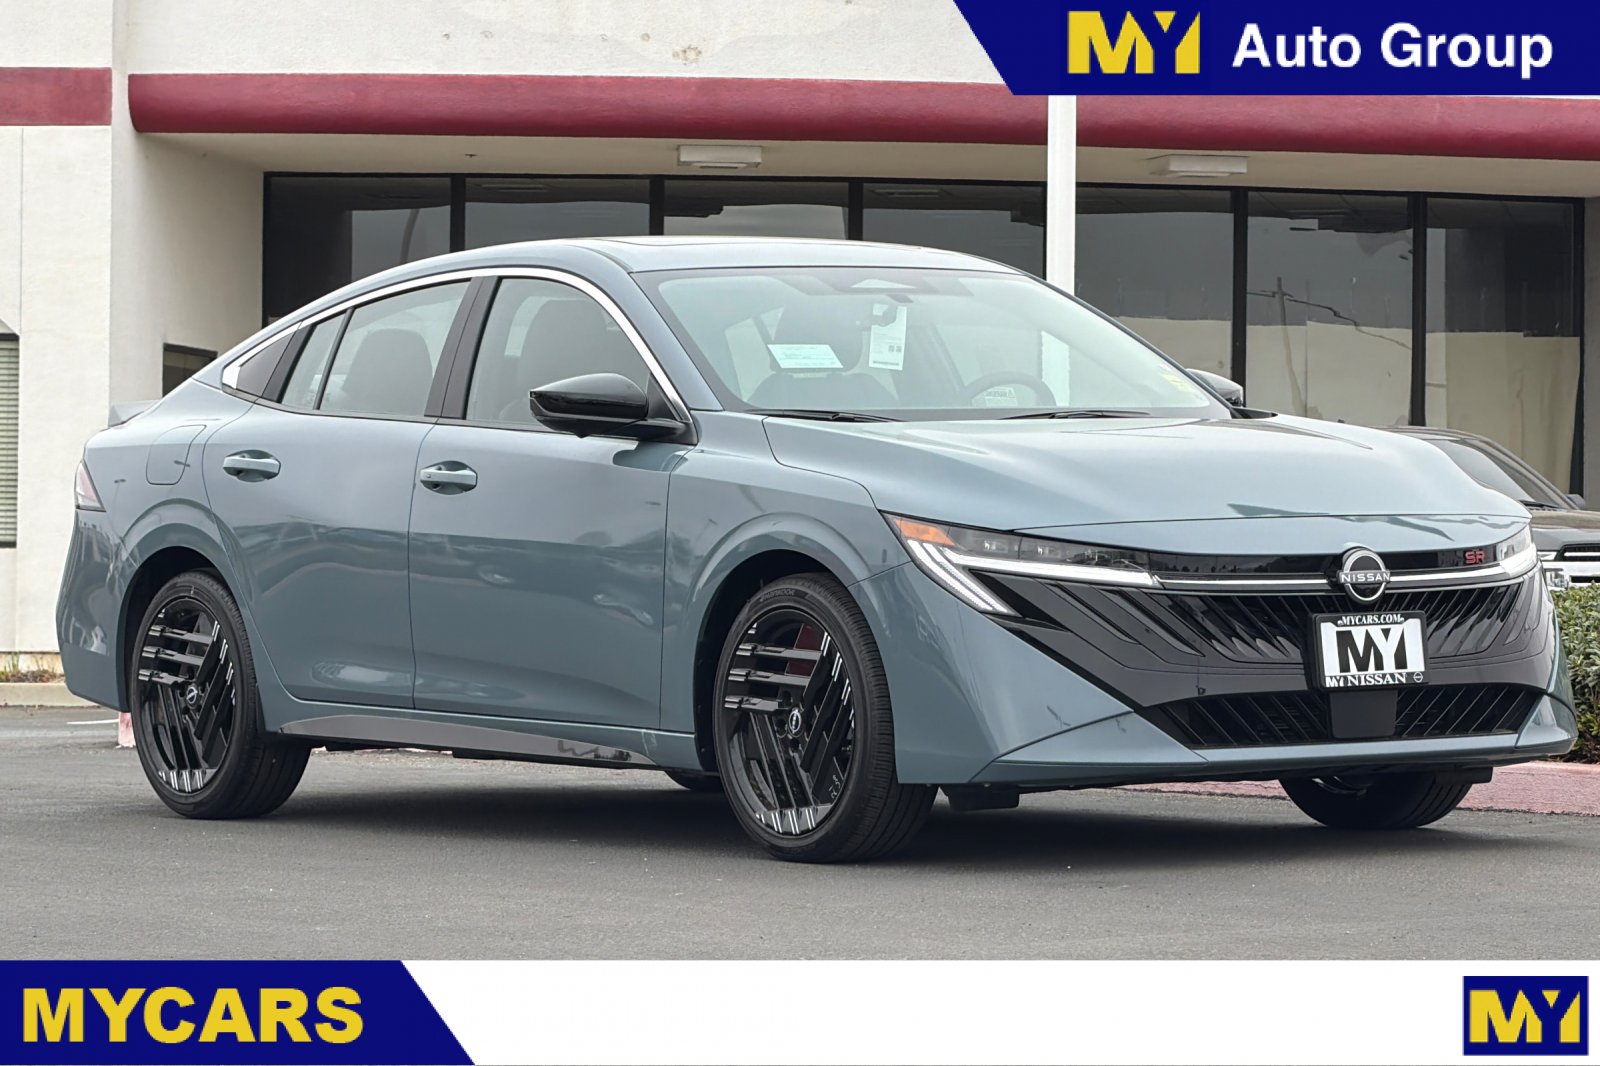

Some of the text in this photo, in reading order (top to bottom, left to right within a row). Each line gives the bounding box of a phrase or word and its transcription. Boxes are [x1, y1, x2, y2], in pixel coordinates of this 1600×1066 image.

[1465, 551, 1486, 564] SR
[1340, 572, 1391, 583] NISSAN
[1341, 613, 1401, 626] MYCARS.COM
[1336, 627, 1408, 674] MY
[1325, 672, 1407, 688] MY NISSAN
